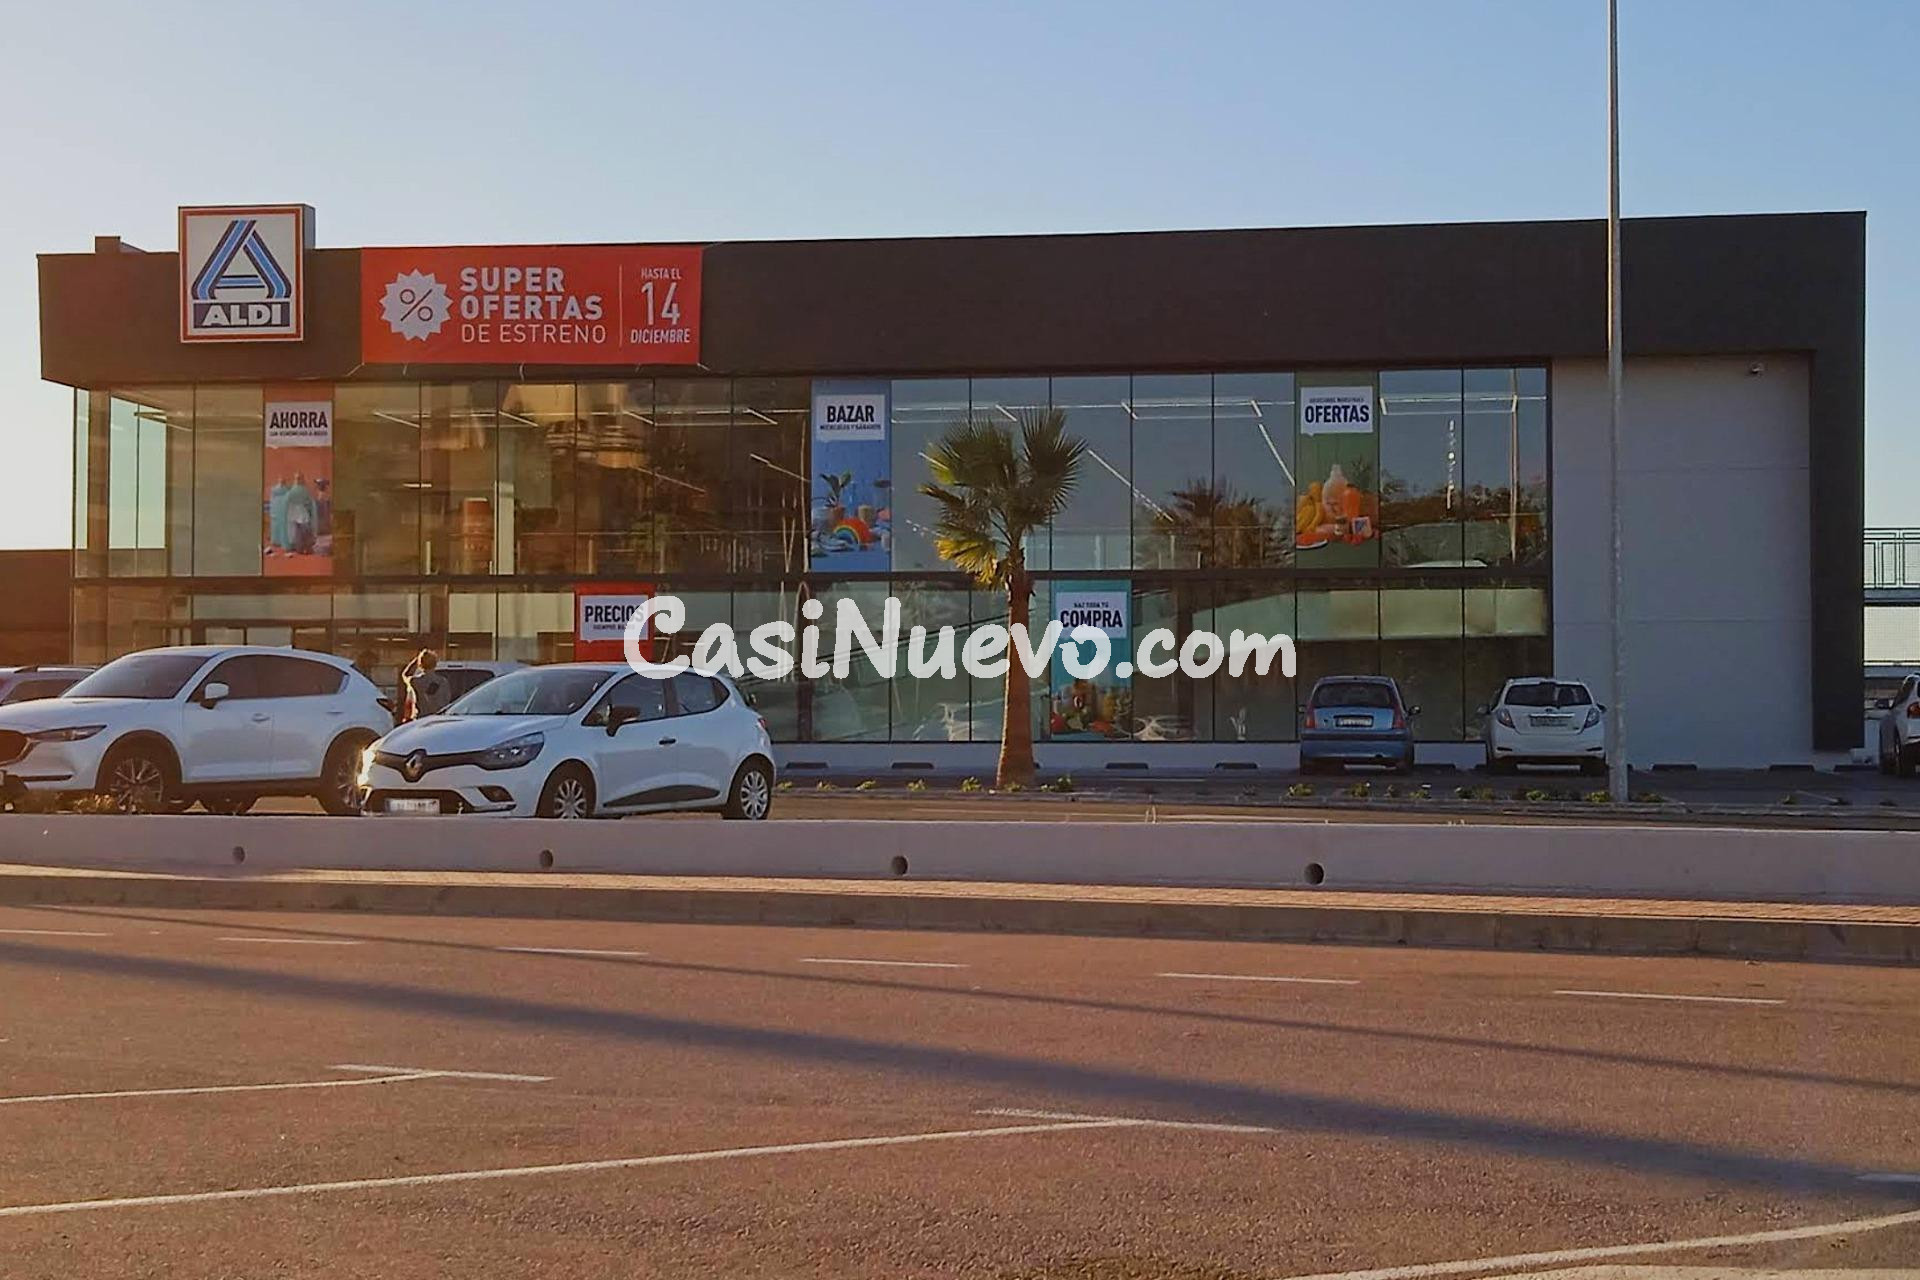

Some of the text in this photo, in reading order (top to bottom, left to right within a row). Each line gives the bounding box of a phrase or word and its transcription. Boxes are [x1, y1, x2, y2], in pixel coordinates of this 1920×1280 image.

[460, 267, 564, 292] SUPER
[642, 268, 681, 279] HASTA EL
[460, 295, 602, 320] OFERTAS
[641, 282, 680, 325] 14
[202, 304, 281, 326] ALDI
[462, 324, 606, 343] DE ESTRENO
[630, 328, 690, 344] DICIEMBRE
[269, 411, 328, 429] AHORRA
[827, 405, 875, 423] BAZAR
[1305, 405, 1369, 423] OFERTAS
[1060, 610, 1123, 628] COMPRA
